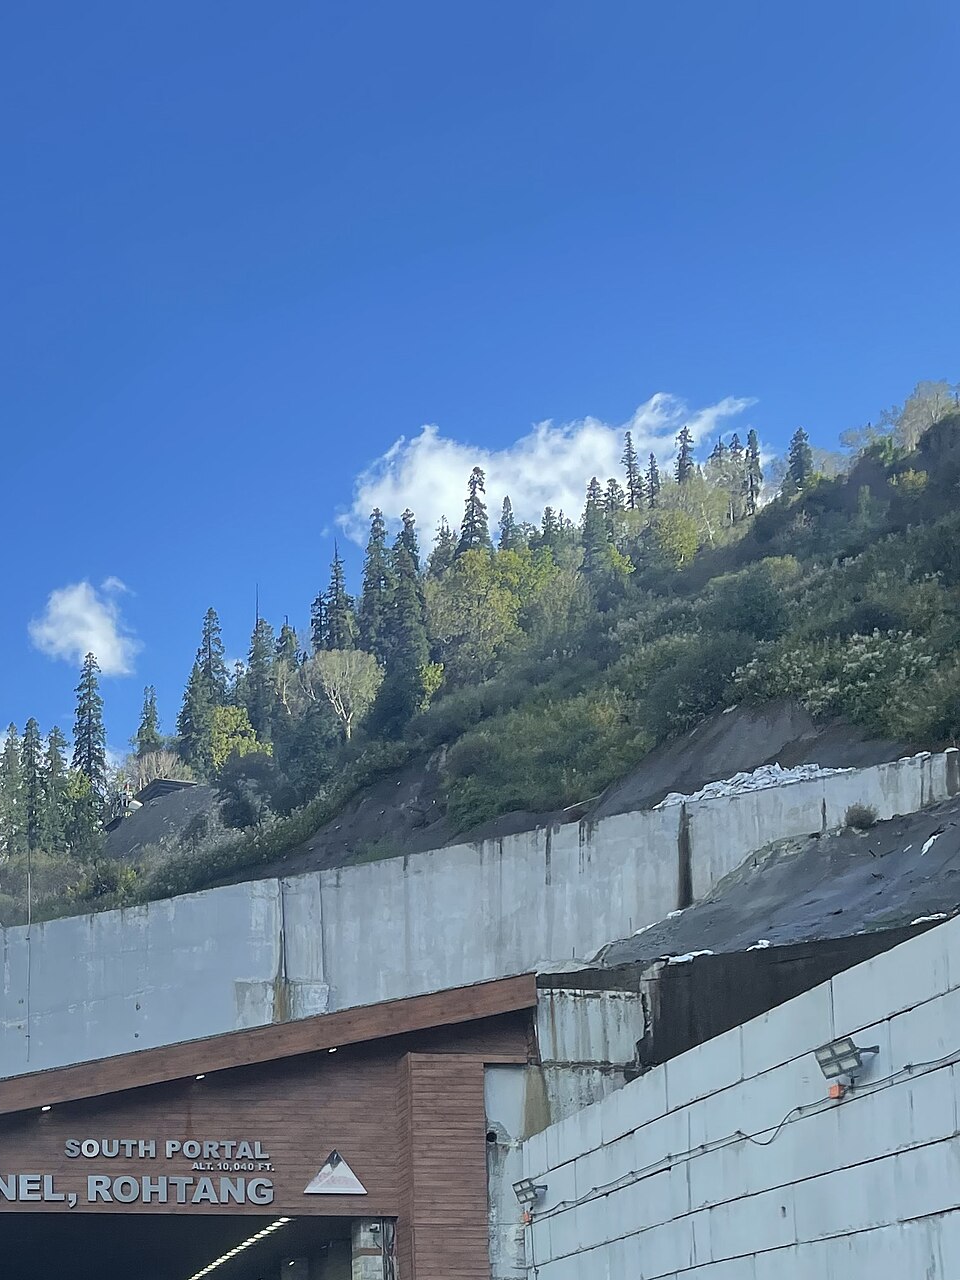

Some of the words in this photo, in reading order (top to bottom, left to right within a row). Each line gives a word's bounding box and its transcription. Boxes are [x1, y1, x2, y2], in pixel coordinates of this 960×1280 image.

[64, 1139, 156, 1158] SOUTH
[165, 1140, 270, 1160] PORTAL
[191, 1161, 214, 1171] ALT.
[216, 1162, 254, 1172] 10,040
[258, 1163, 275, 1172] FT.
[87, 1175, 275, 1205] ROHTANG
